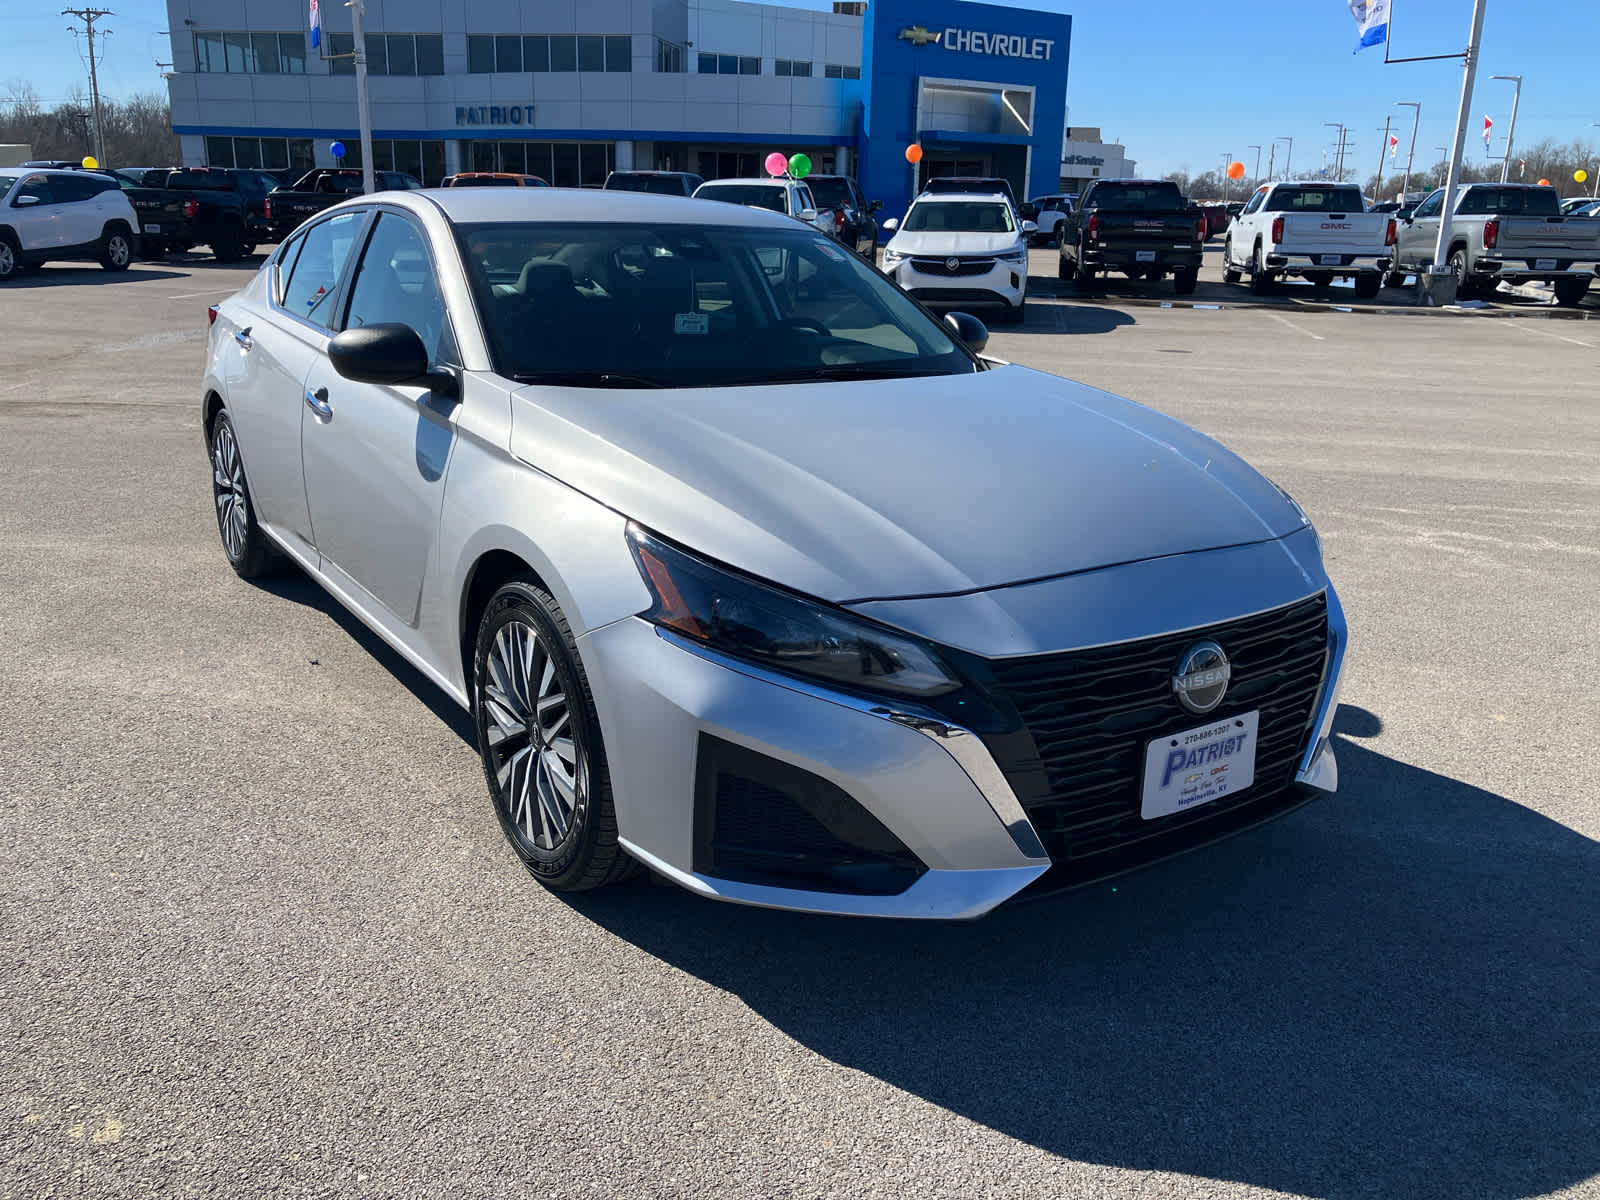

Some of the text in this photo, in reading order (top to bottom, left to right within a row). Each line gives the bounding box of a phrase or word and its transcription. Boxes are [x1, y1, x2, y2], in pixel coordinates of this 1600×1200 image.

[944, 28, 1055, 61] CHEVROLET
[455, 105, 535, 125] PATRIOT
[1161, 734, 1247, 787] PATRIOT
